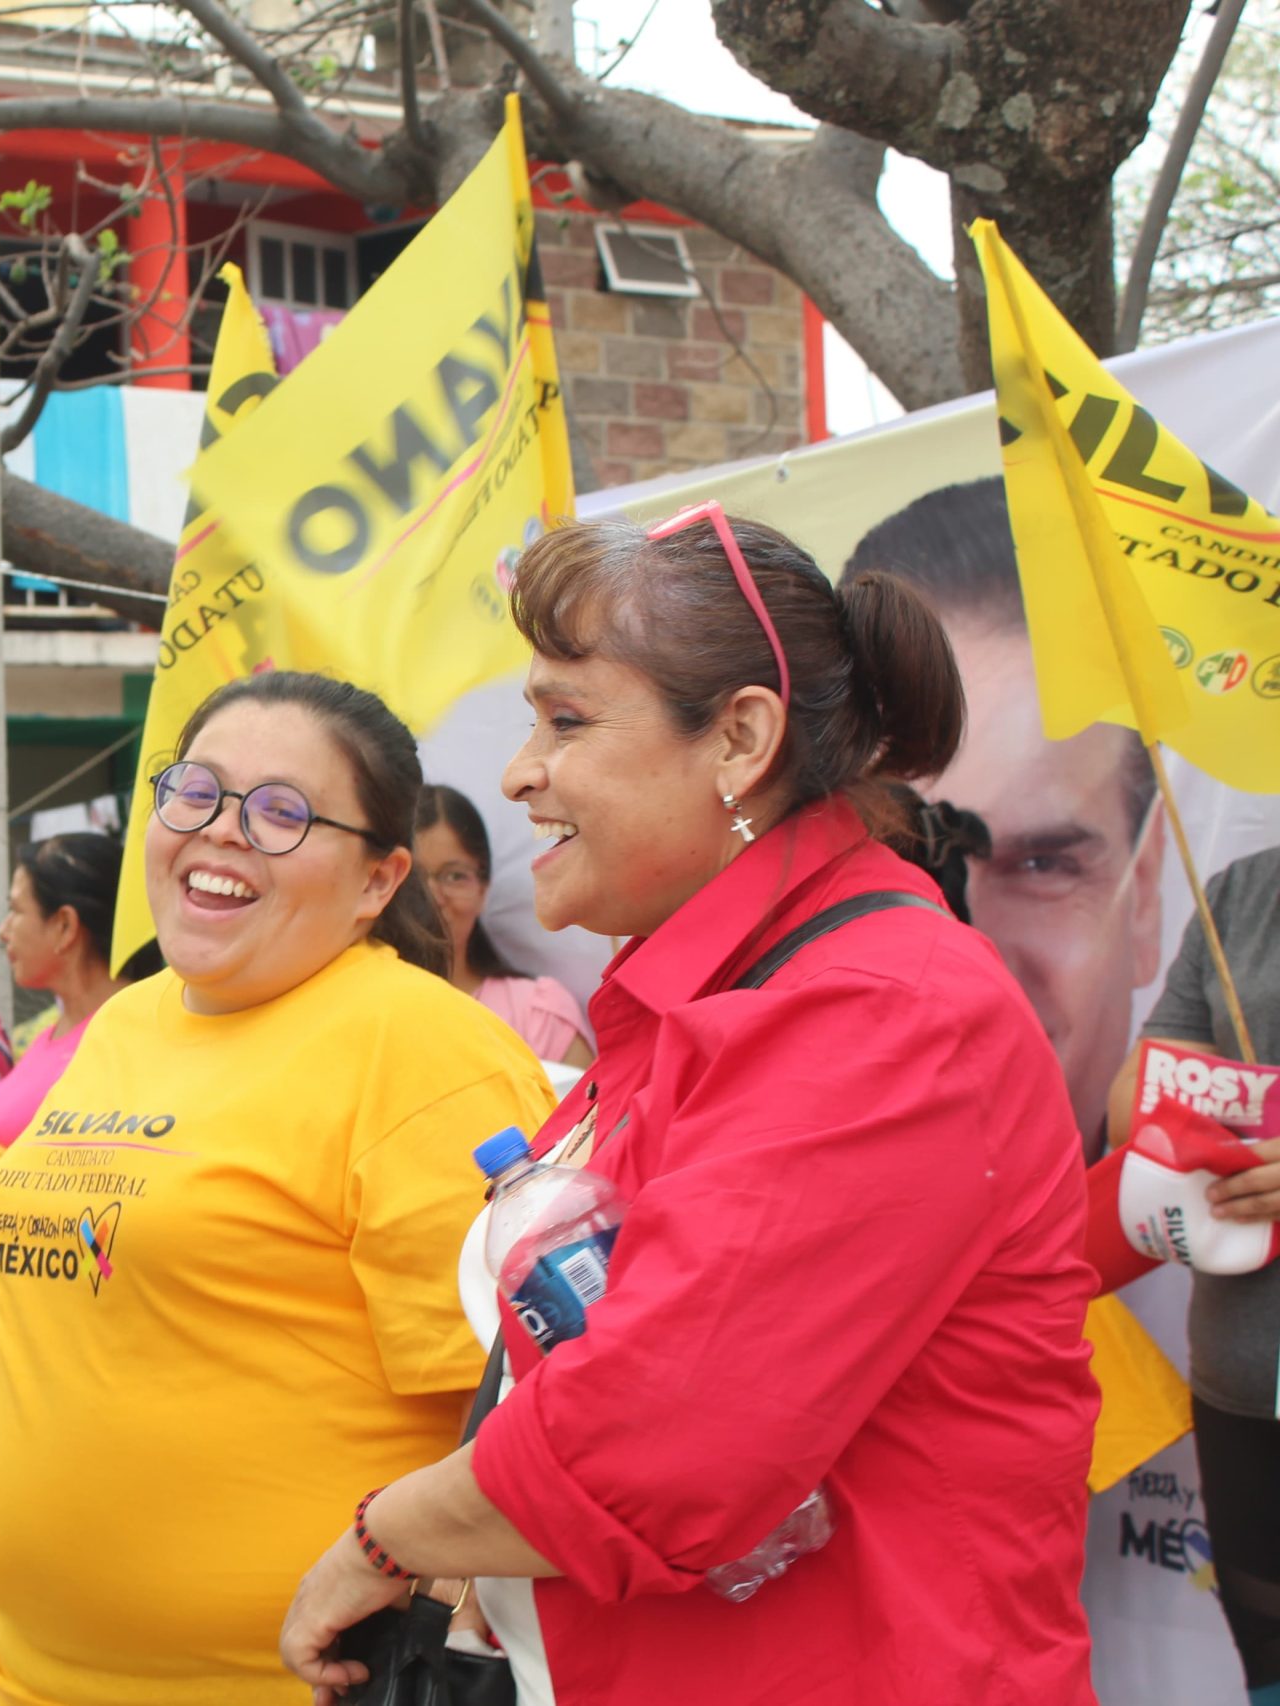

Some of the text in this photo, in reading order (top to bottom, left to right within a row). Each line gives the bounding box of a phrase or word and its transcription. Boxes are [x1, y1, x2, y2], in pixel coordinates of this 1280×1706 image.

[1113, 533, 1261, 594] TADO
[1142, 1047, 1279, 1108] ROSY
[35, 1110, 176, 1138] SILVANO
[46, 1149, 116, 1167] CANDIDATO
[78, 1173, 148, 1199] FEDERAL
[62, 1217, 78, 1240] POR
